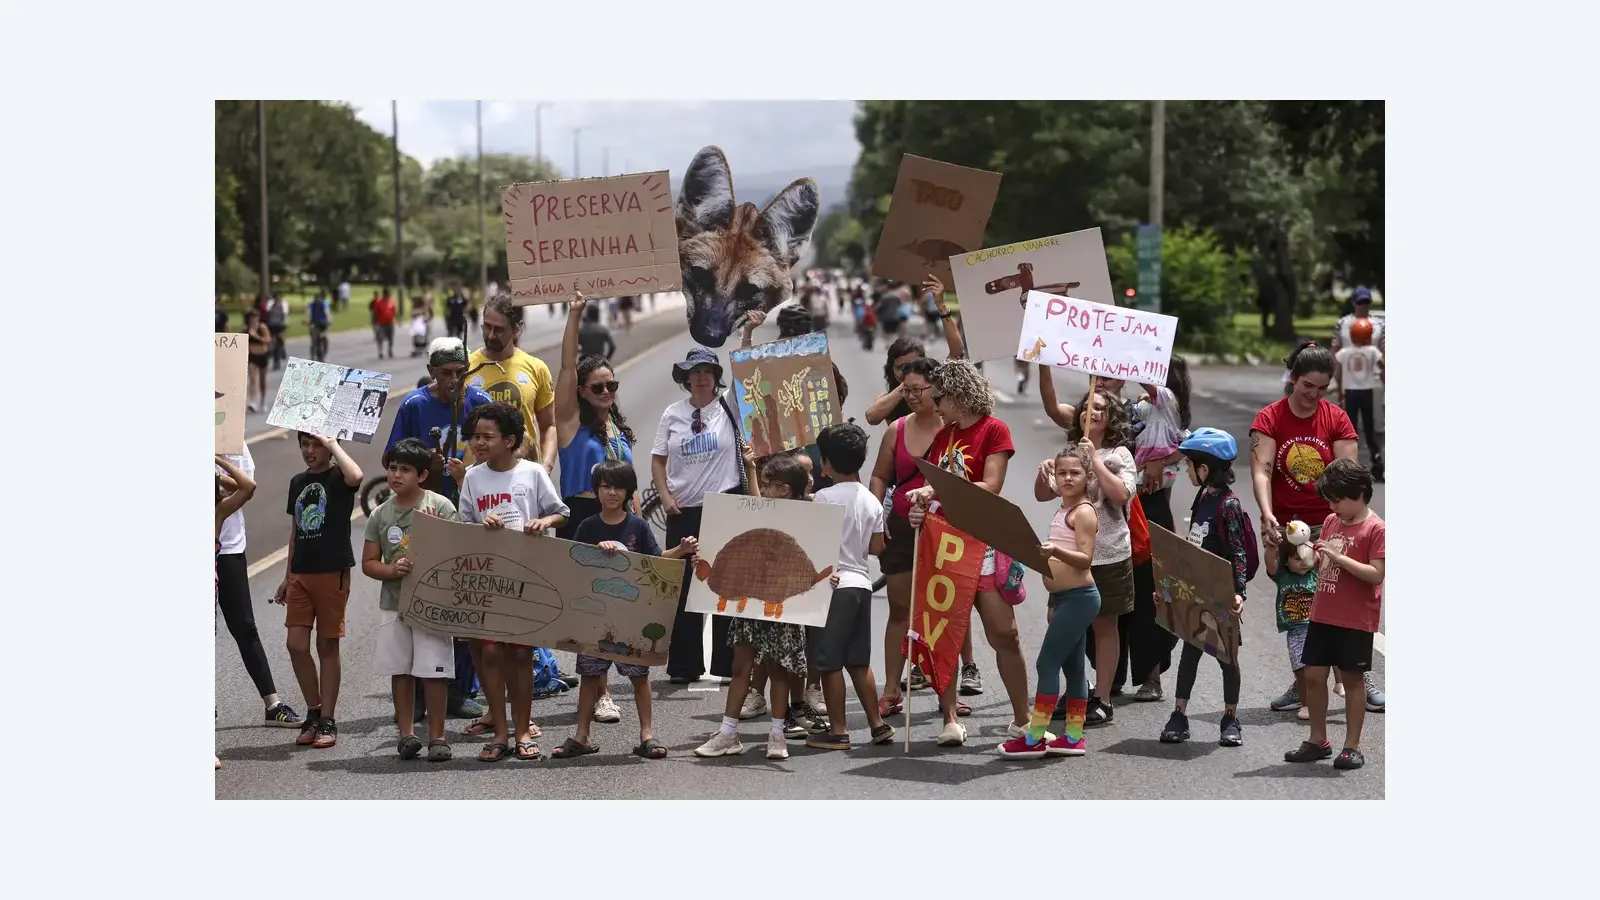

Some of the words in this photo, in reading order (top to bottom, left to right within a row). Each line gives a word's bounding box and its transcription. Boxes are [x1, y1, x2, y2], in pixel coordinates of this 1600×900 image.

[530, 191, 643, 226] PRESERVA
[966, 245, 1016, 266] CACHORRO
[1022, 238, 1061, 251] VINAGRE
[534, 281, 565, 295] ÁGUA
[573, 278, 580, 291] É
[1092, 334, 1103, 348] A
[737, 496, 776, 511] JABUTI
[451, 557, 495, 572] SALVE
[426, 570, 439, 586] A
[450, 572, 525, 598] SERRINHA!
[452, 592, 493, 608] SALVE
